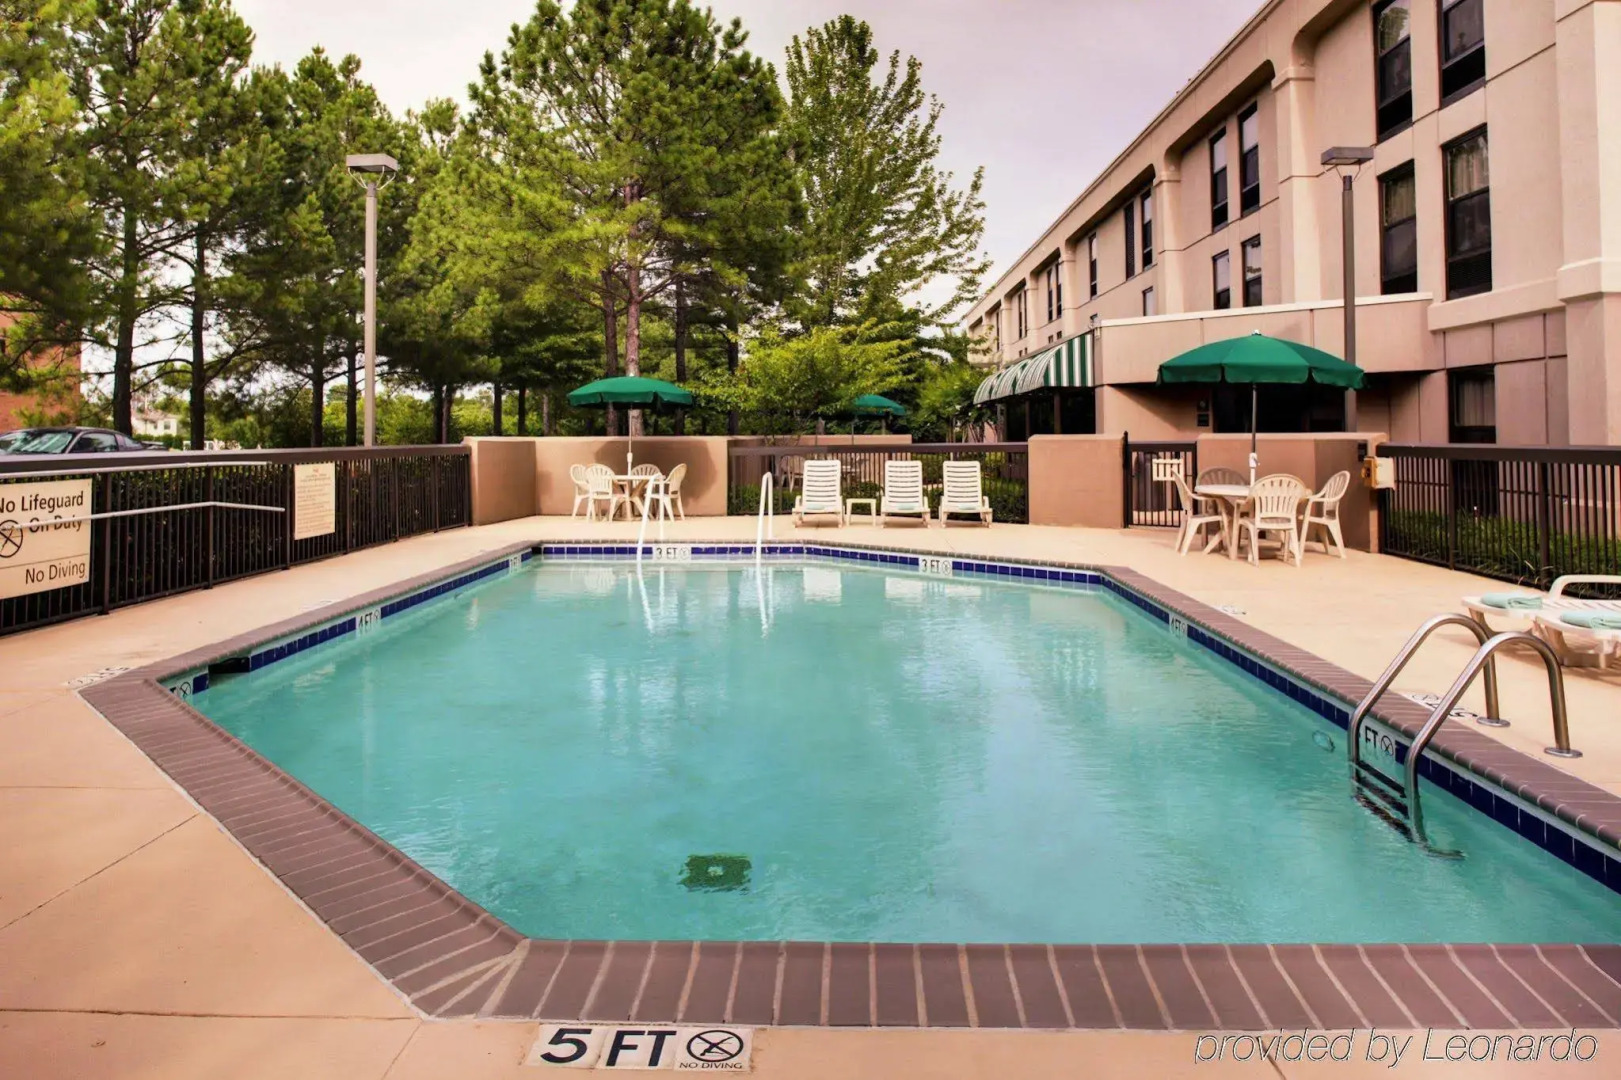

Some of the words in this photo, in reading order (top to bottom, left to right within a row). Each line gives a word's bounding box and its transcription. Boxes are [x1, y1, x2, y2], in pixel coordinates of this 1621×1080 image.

[21, 490, 84, 513] Lifeguard
[25, 568, 44, 585] No
[49, 561, 86, 580] Diving
[930, 559, 941, 573] FT
[1364, 725, 1379, 749] FT
[540, 1028, 592, 1063] 5
[606, 1030, 677, 1067] FT
